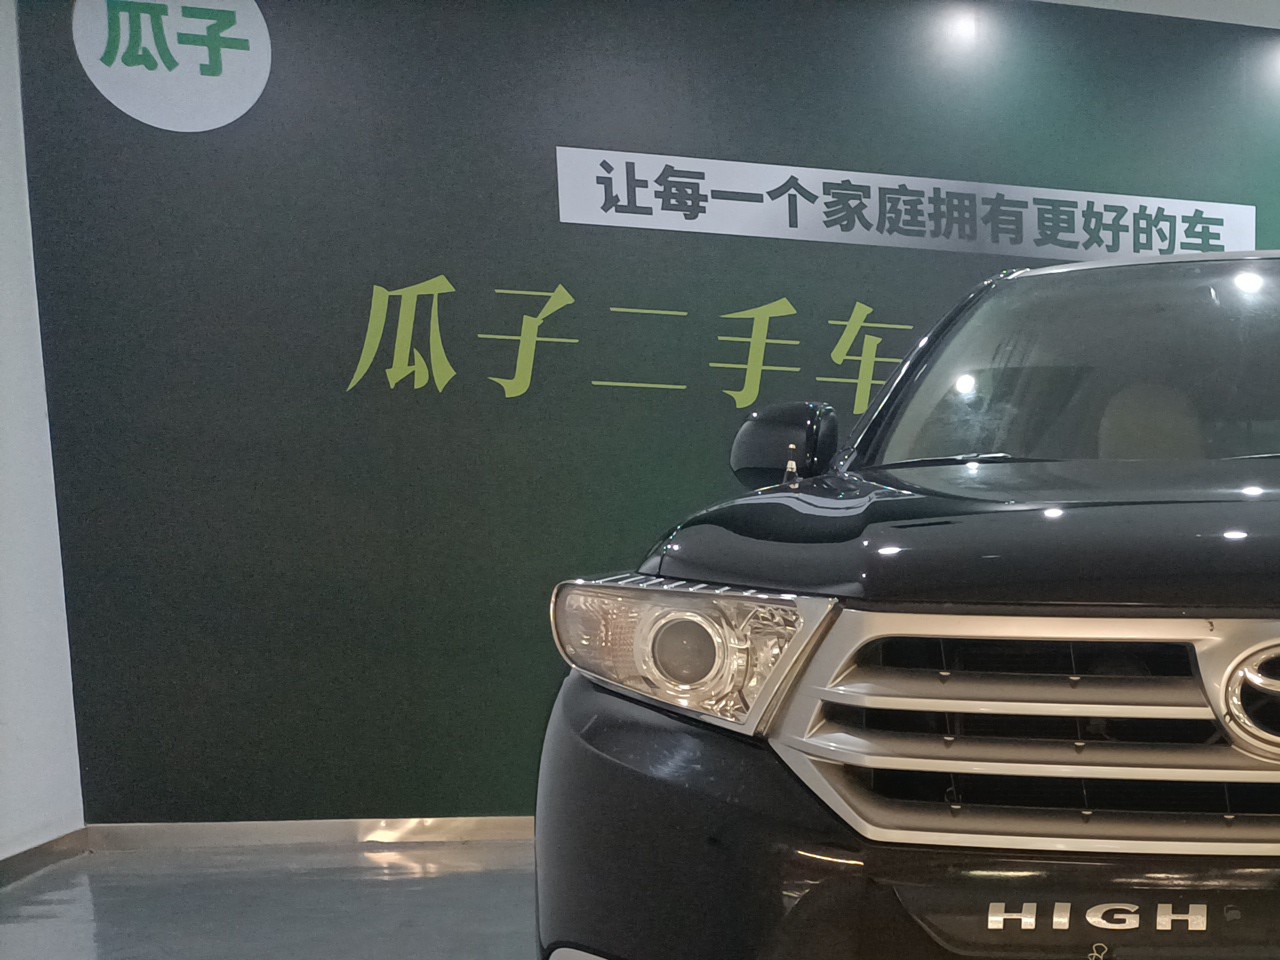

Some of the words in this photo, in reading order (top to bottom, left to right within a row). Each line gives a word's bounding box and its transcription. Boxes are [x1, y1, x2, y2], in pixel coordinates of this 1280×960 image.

[100, 0, 250, 77] 瓜子
[596, 160, 1225, 254] 让每一个家庭拥有更好的车
[346, 274, 914, 415] 瓜子二手车
[987, 902, 1208, 931] HIGH
